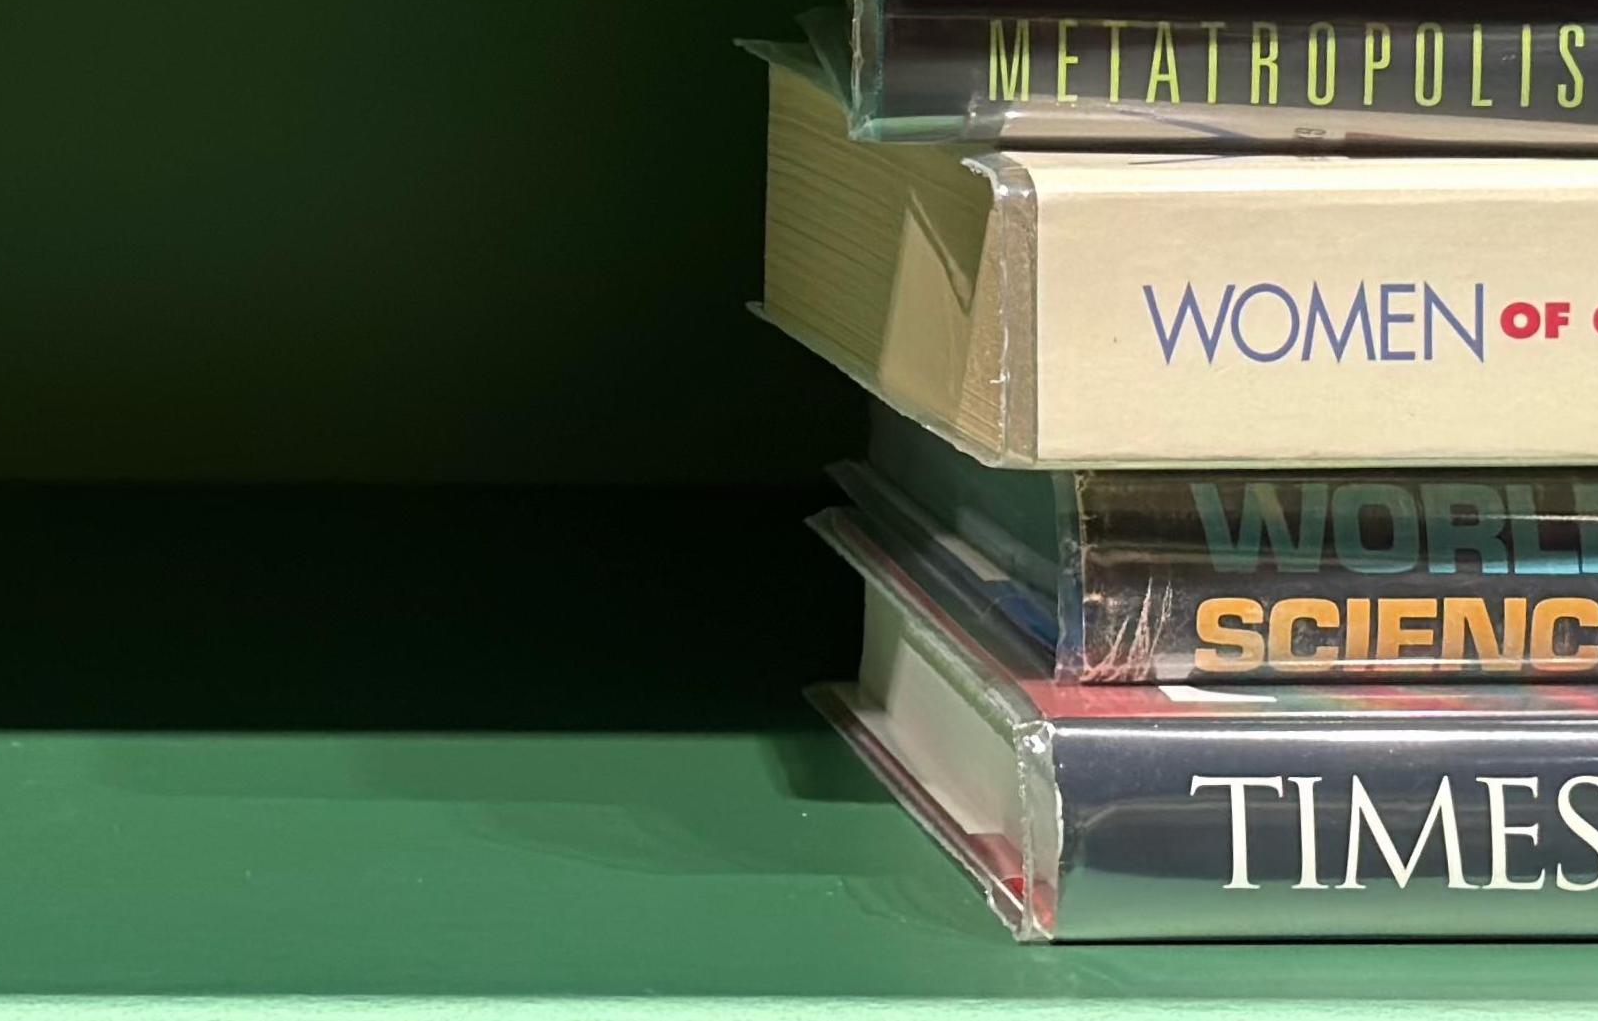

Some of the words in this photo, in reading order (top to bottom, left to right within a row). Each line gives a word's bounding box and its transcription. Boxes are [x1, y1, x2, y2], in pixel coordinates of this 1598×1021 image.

[989, 20, 1586, 109] METATROPOLIS
[1143, 282, 1484, 364] WOMEN
[1499, 301, 1571, 340] OF
